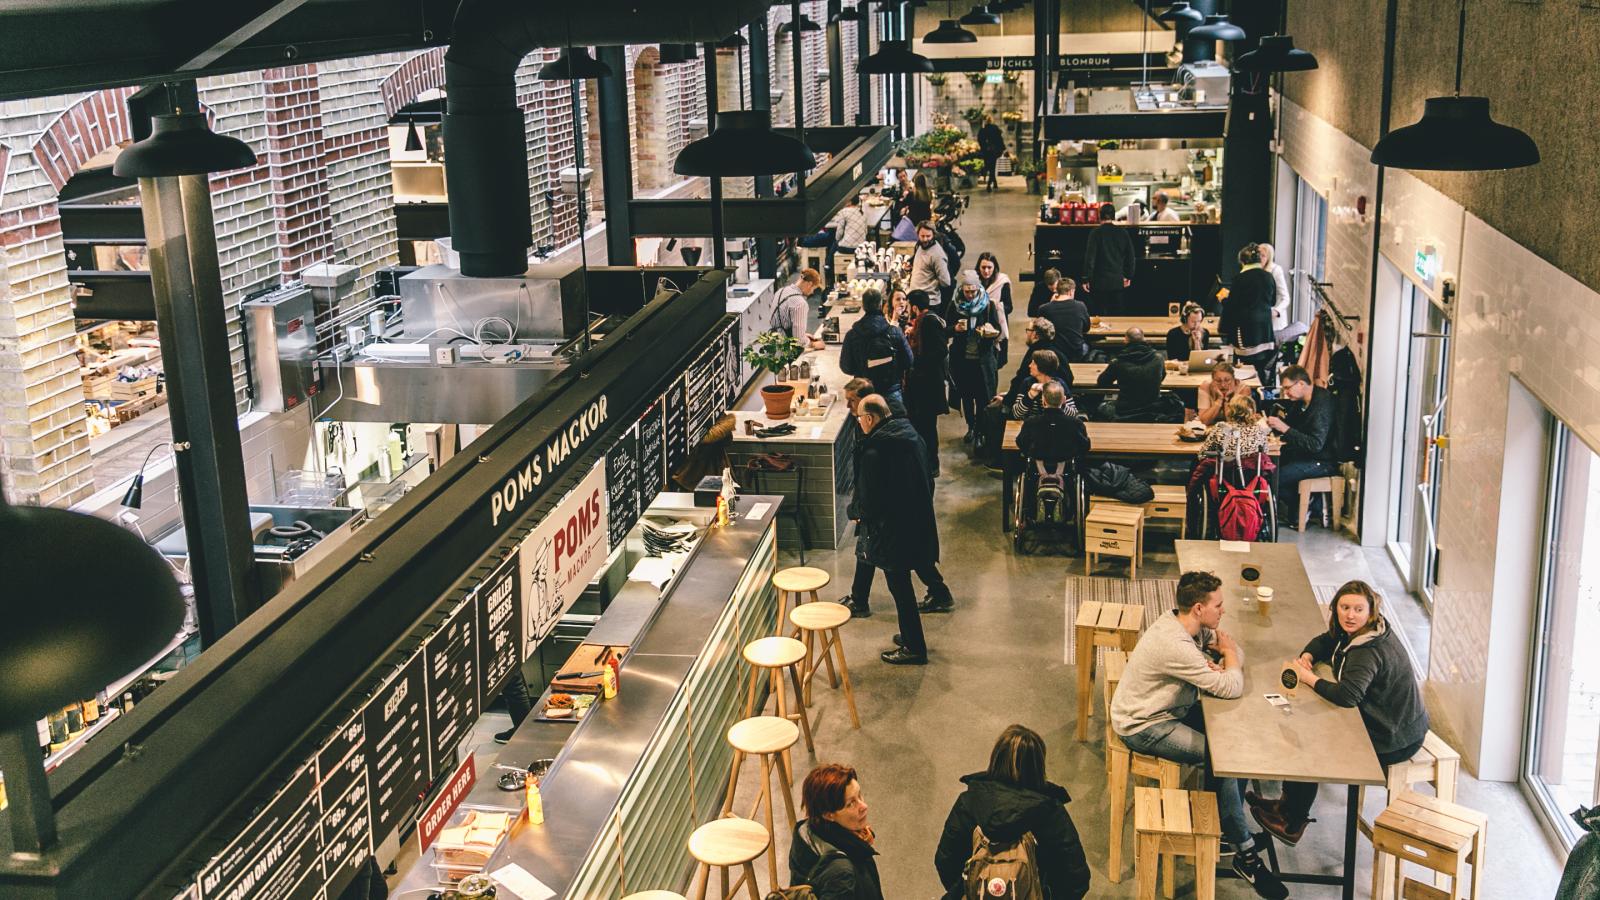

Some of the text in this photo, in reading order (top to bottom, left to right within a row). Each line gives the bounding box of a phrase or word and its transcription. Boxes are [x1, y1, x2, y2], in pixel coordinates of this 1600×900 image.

[986, 60, 1033, 68] BUNCHES
[1060, 58, 1110, 66] BLOMRUM
[491, 454, 543, 527] POMS
[547, 394, 608, 473] MACKOR
[553, 488, 600, 574] POMS
[567, 546, 592, 584] MACKOR
[488, 575, 512, 613] GRILLED
[489, 593, 512, 631] CHEESE
[387, 684, 406, 714] SIDES
[425, 766, 471, 837] ORDER HERE
[254, 857, 268, 881] ON
[267, 841, 283, 868] RYE
[204, 866, 221, 895] BLT
